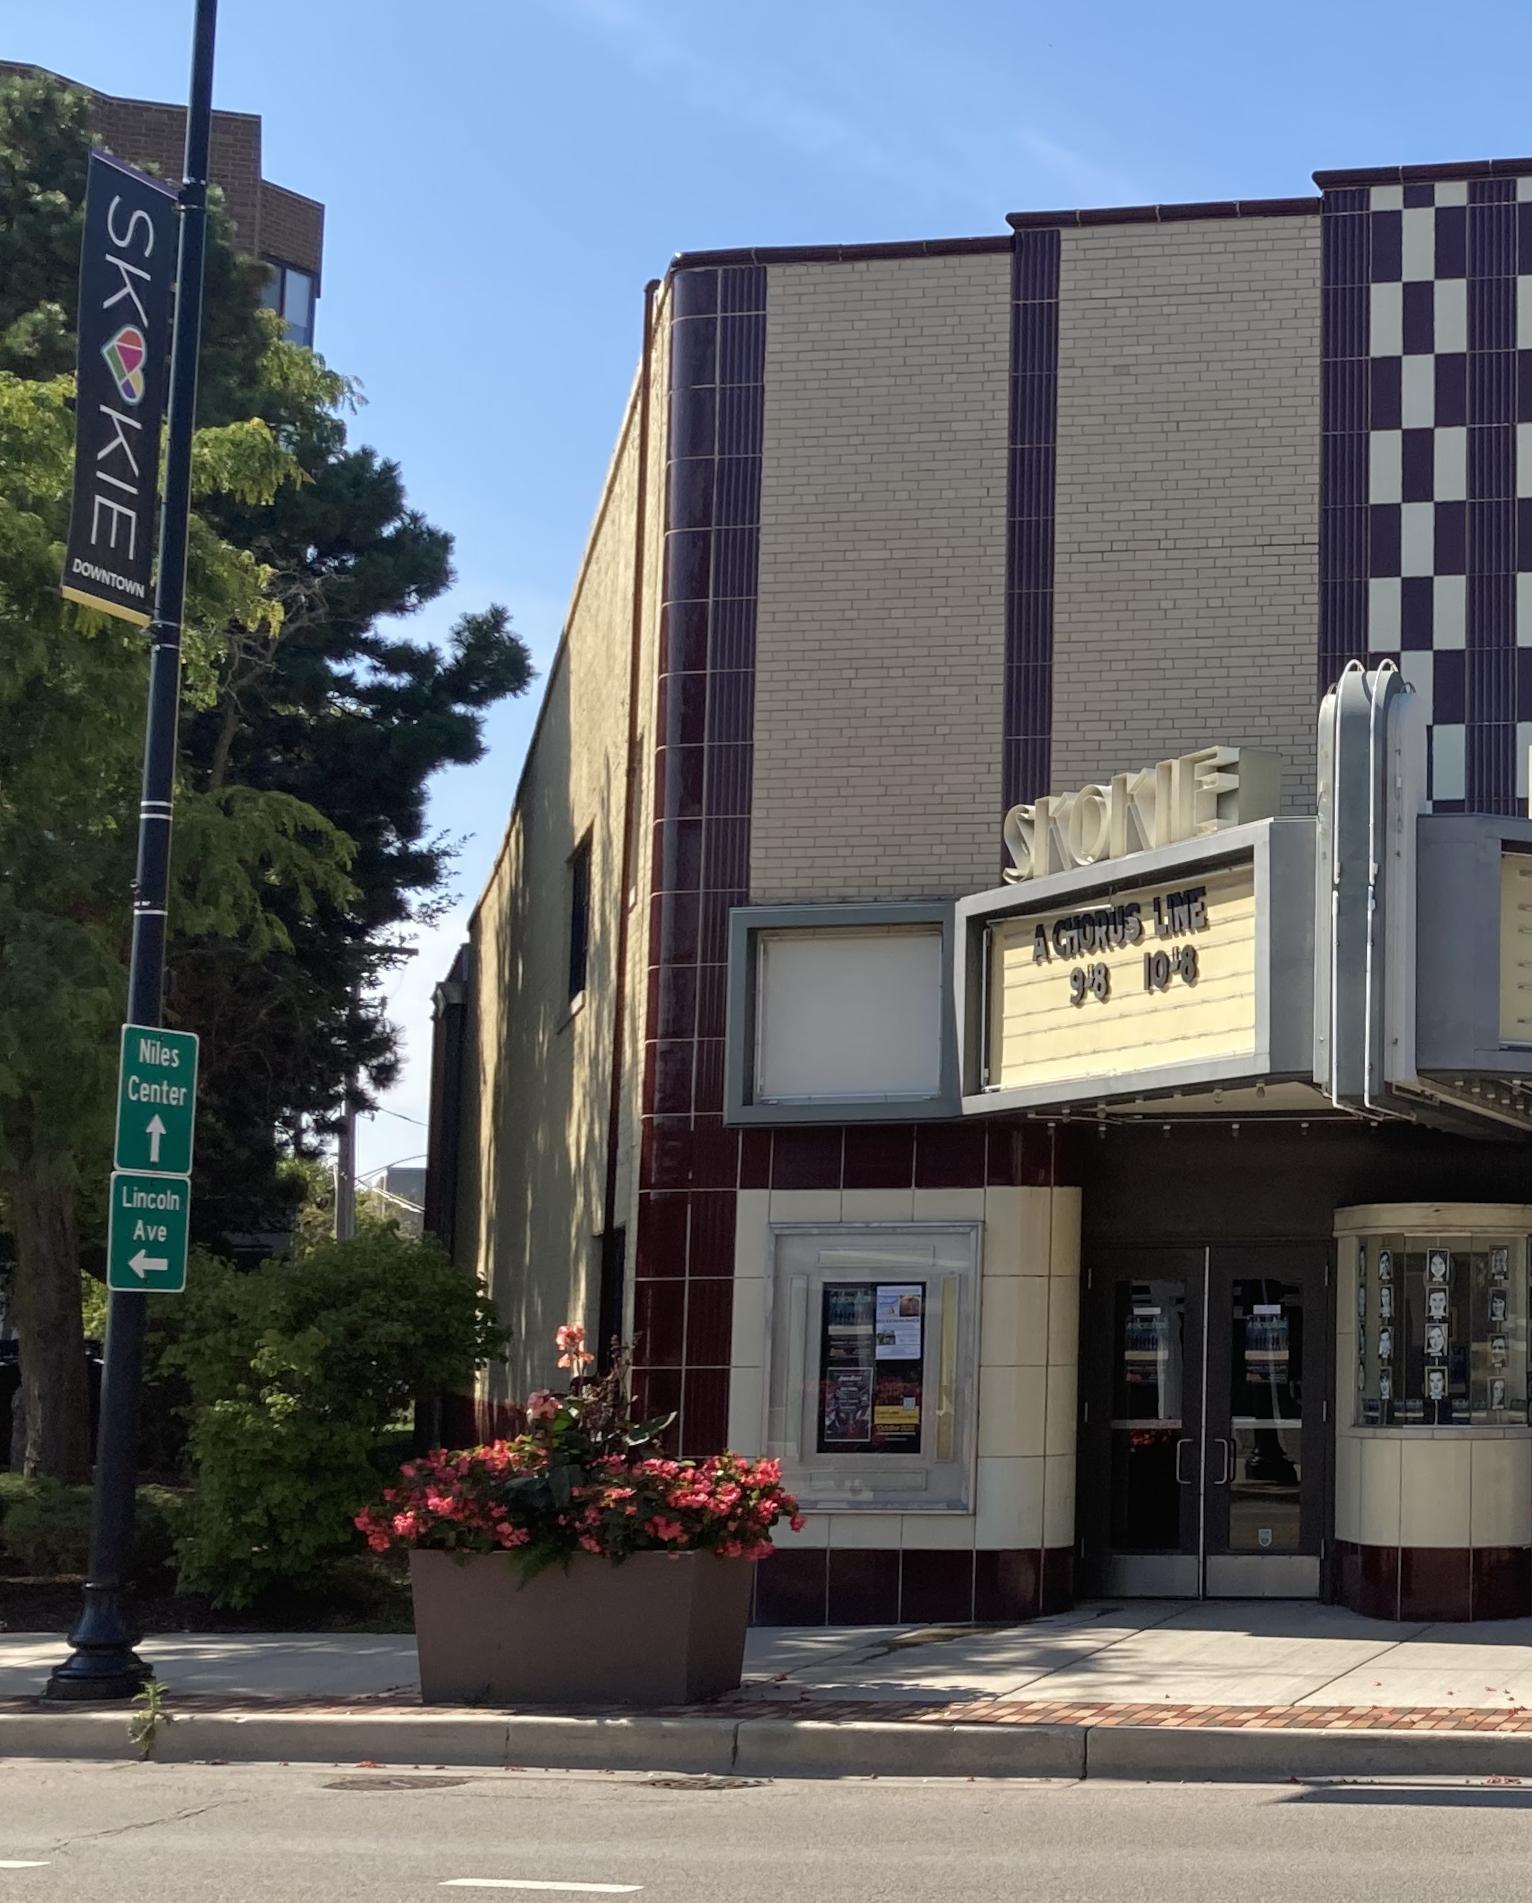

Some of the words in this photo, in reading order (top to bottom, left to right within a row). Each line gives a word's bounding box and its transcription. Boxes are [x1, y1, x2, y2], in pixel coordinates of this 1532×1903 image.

[72, 557, 146, 599] DOWNTOWN
[1003, 745, 1242, 884] SKOKIE
[1033, 924, 1051, 962] A
[1053, 903, 1143, 956] CHORUS
[1153, 887, 1208, 938] LINE
[138, 1038, 180, 1067] Niles
[127, 1075, 187, 1106] Center
[121, 1186, 180, 1211] Lincoln
[133, 1219, 168, 1242] Ave
